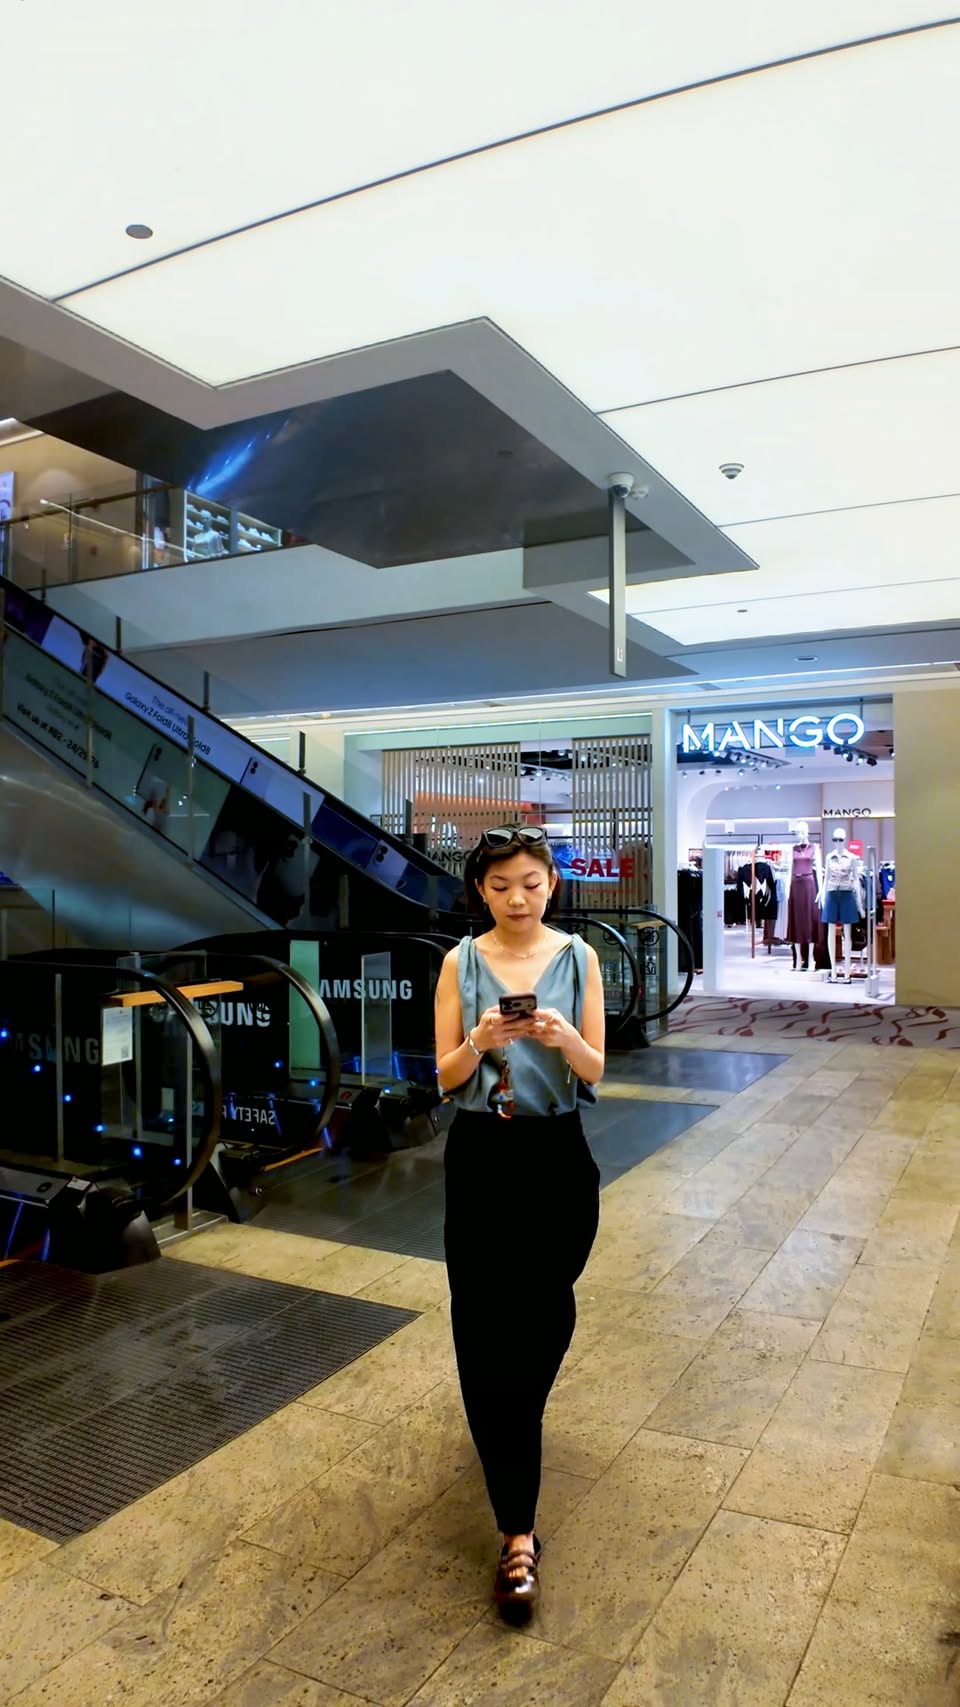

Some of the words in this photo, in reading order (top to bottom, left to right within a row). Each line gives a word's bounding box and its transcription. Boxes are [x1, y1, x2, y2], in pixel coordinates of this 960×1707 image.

[125, 692, 149, 713] Galaxy
[193, 737, 211, 755] old8
[682, 713, 865, 753] MANGO
[823, 808, 871, 817] MANGO
[571, 858, 635, 878] SALE
